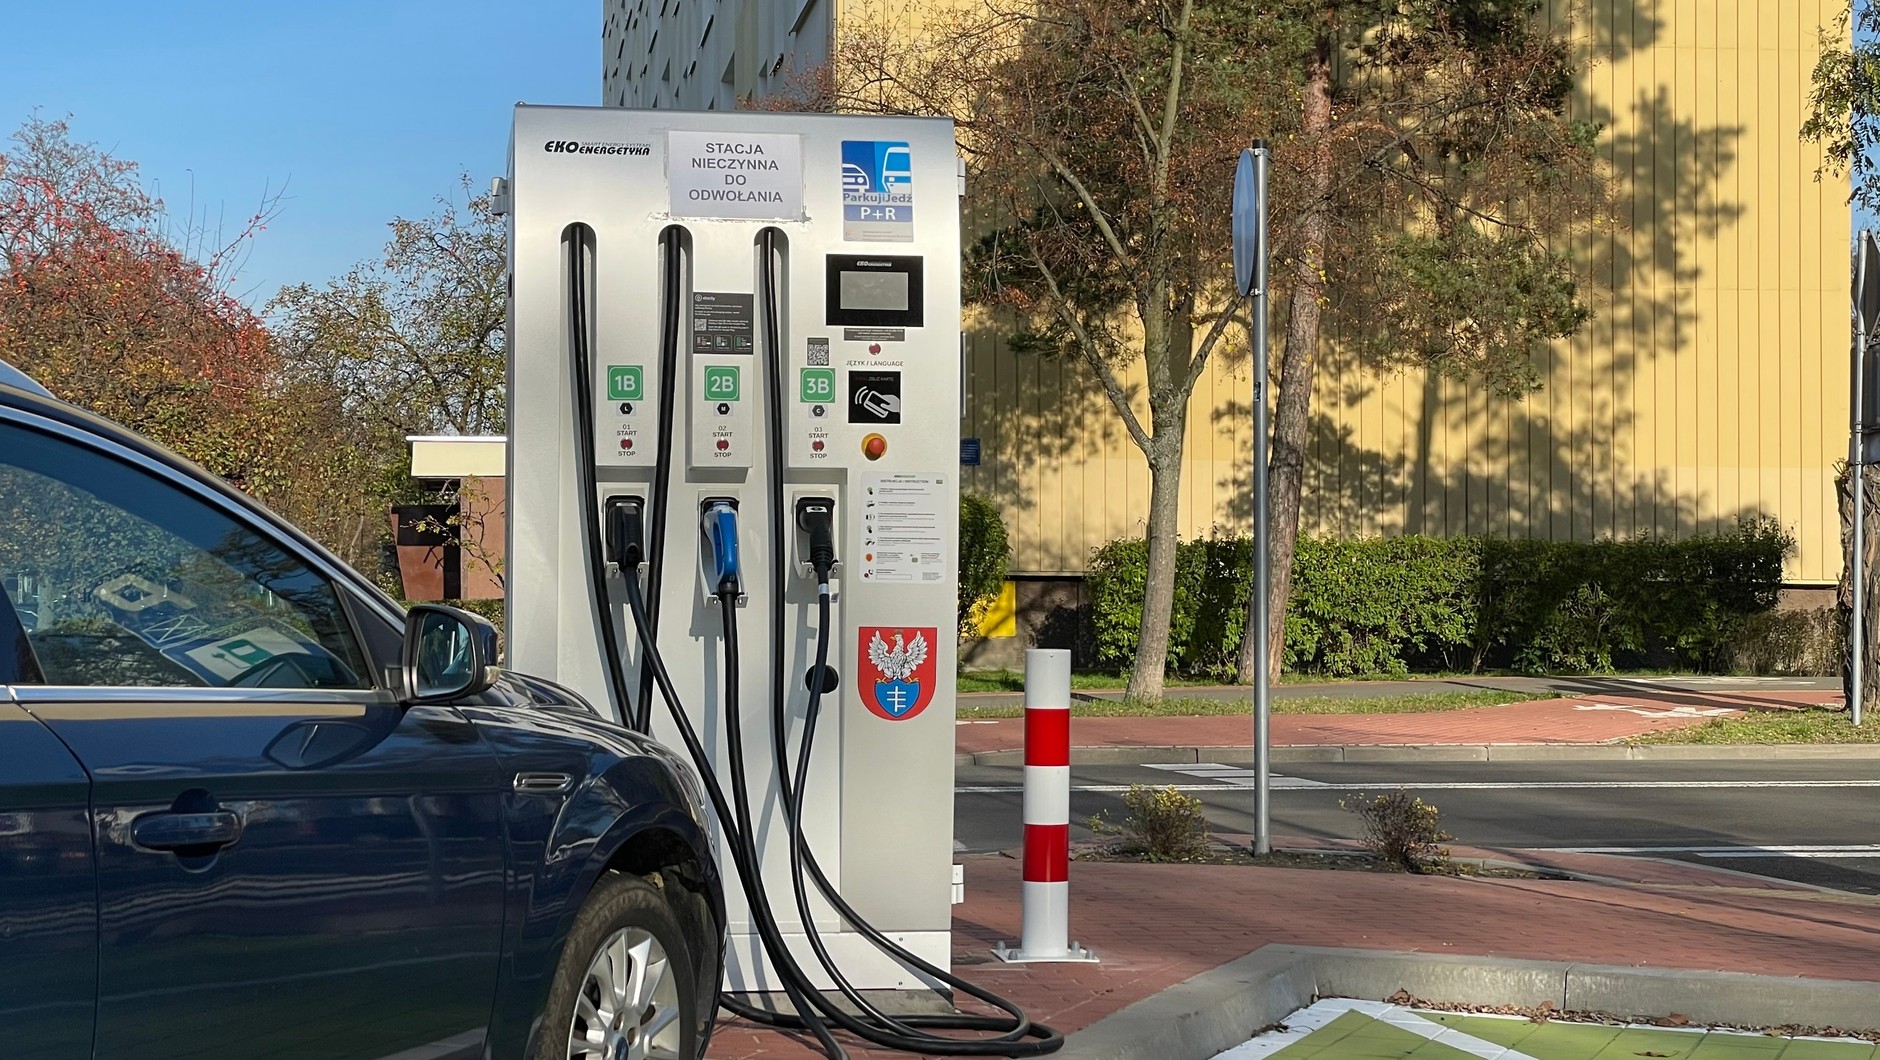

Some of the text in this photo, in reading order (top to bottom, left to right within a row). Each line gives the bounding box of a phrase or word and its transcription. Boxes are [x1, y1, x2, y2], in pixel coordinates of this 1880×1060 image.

[706, 142, 764, 155] STACJA
[692, 157, 779, 171] NIECZYNNA
[725, 174, 747, 186] DO
[689, 189, 783, 203] ODWOŁANIA
[615, 375, 636, 391] 1B
[711, 376, 734, 391] 2B
[806, 378, 829, 393] 3B
